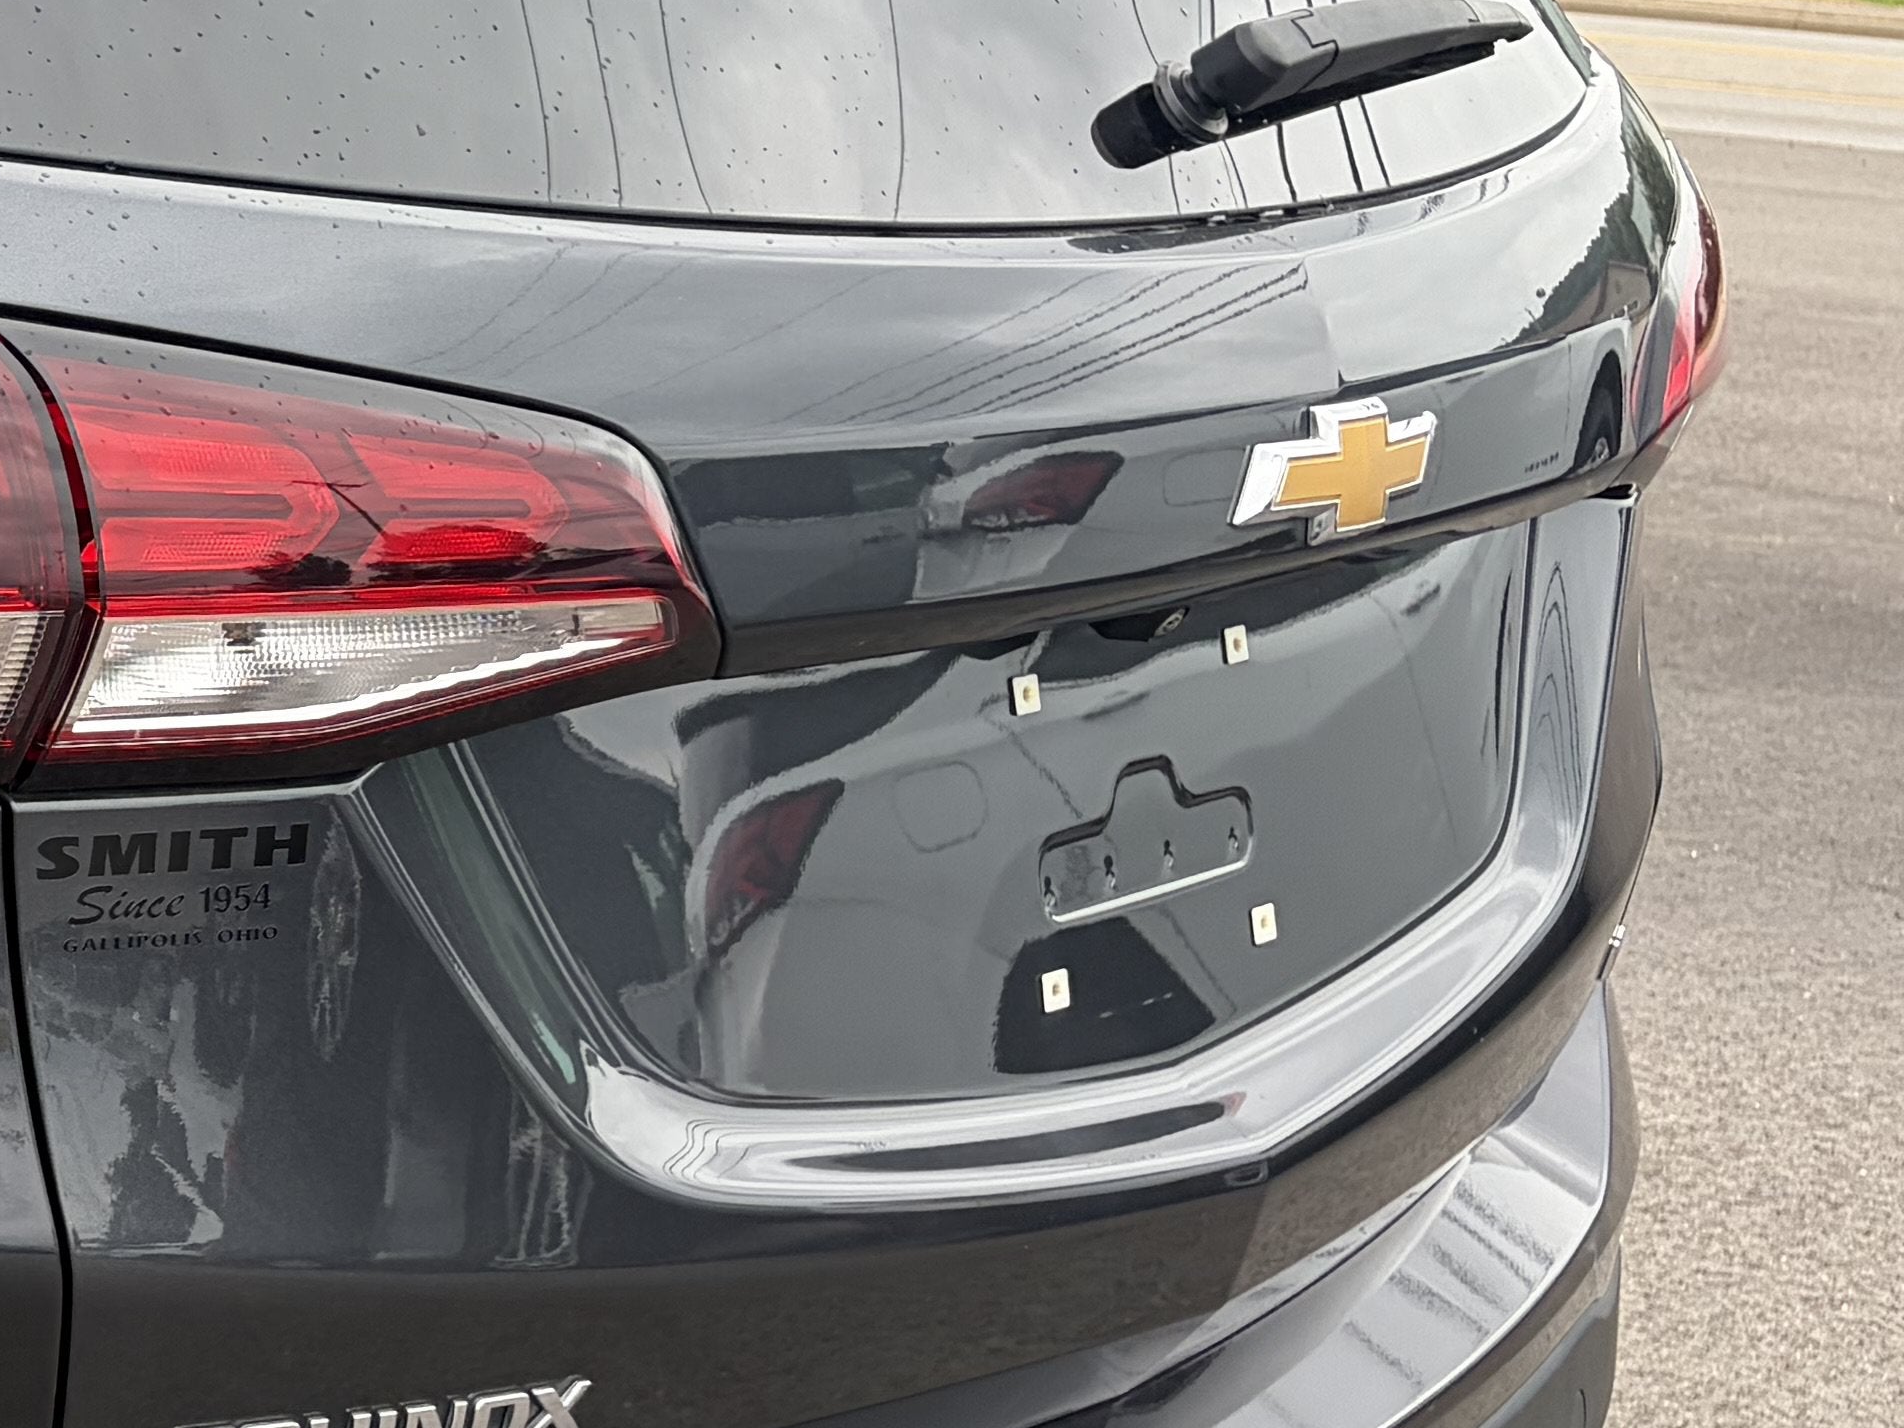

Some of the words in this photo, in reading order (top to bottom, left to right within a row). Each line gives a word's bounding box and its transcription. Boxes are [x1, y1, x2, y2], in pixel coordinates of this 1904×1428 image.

[36, 823, 309, 880] SMITH
[68, 885, 184, 925] Since
[199, 881, 271, 914] 1954
[63, 928, 202, 953] GALLIPOLIS
[217, 926, 279, 944] OHIO
